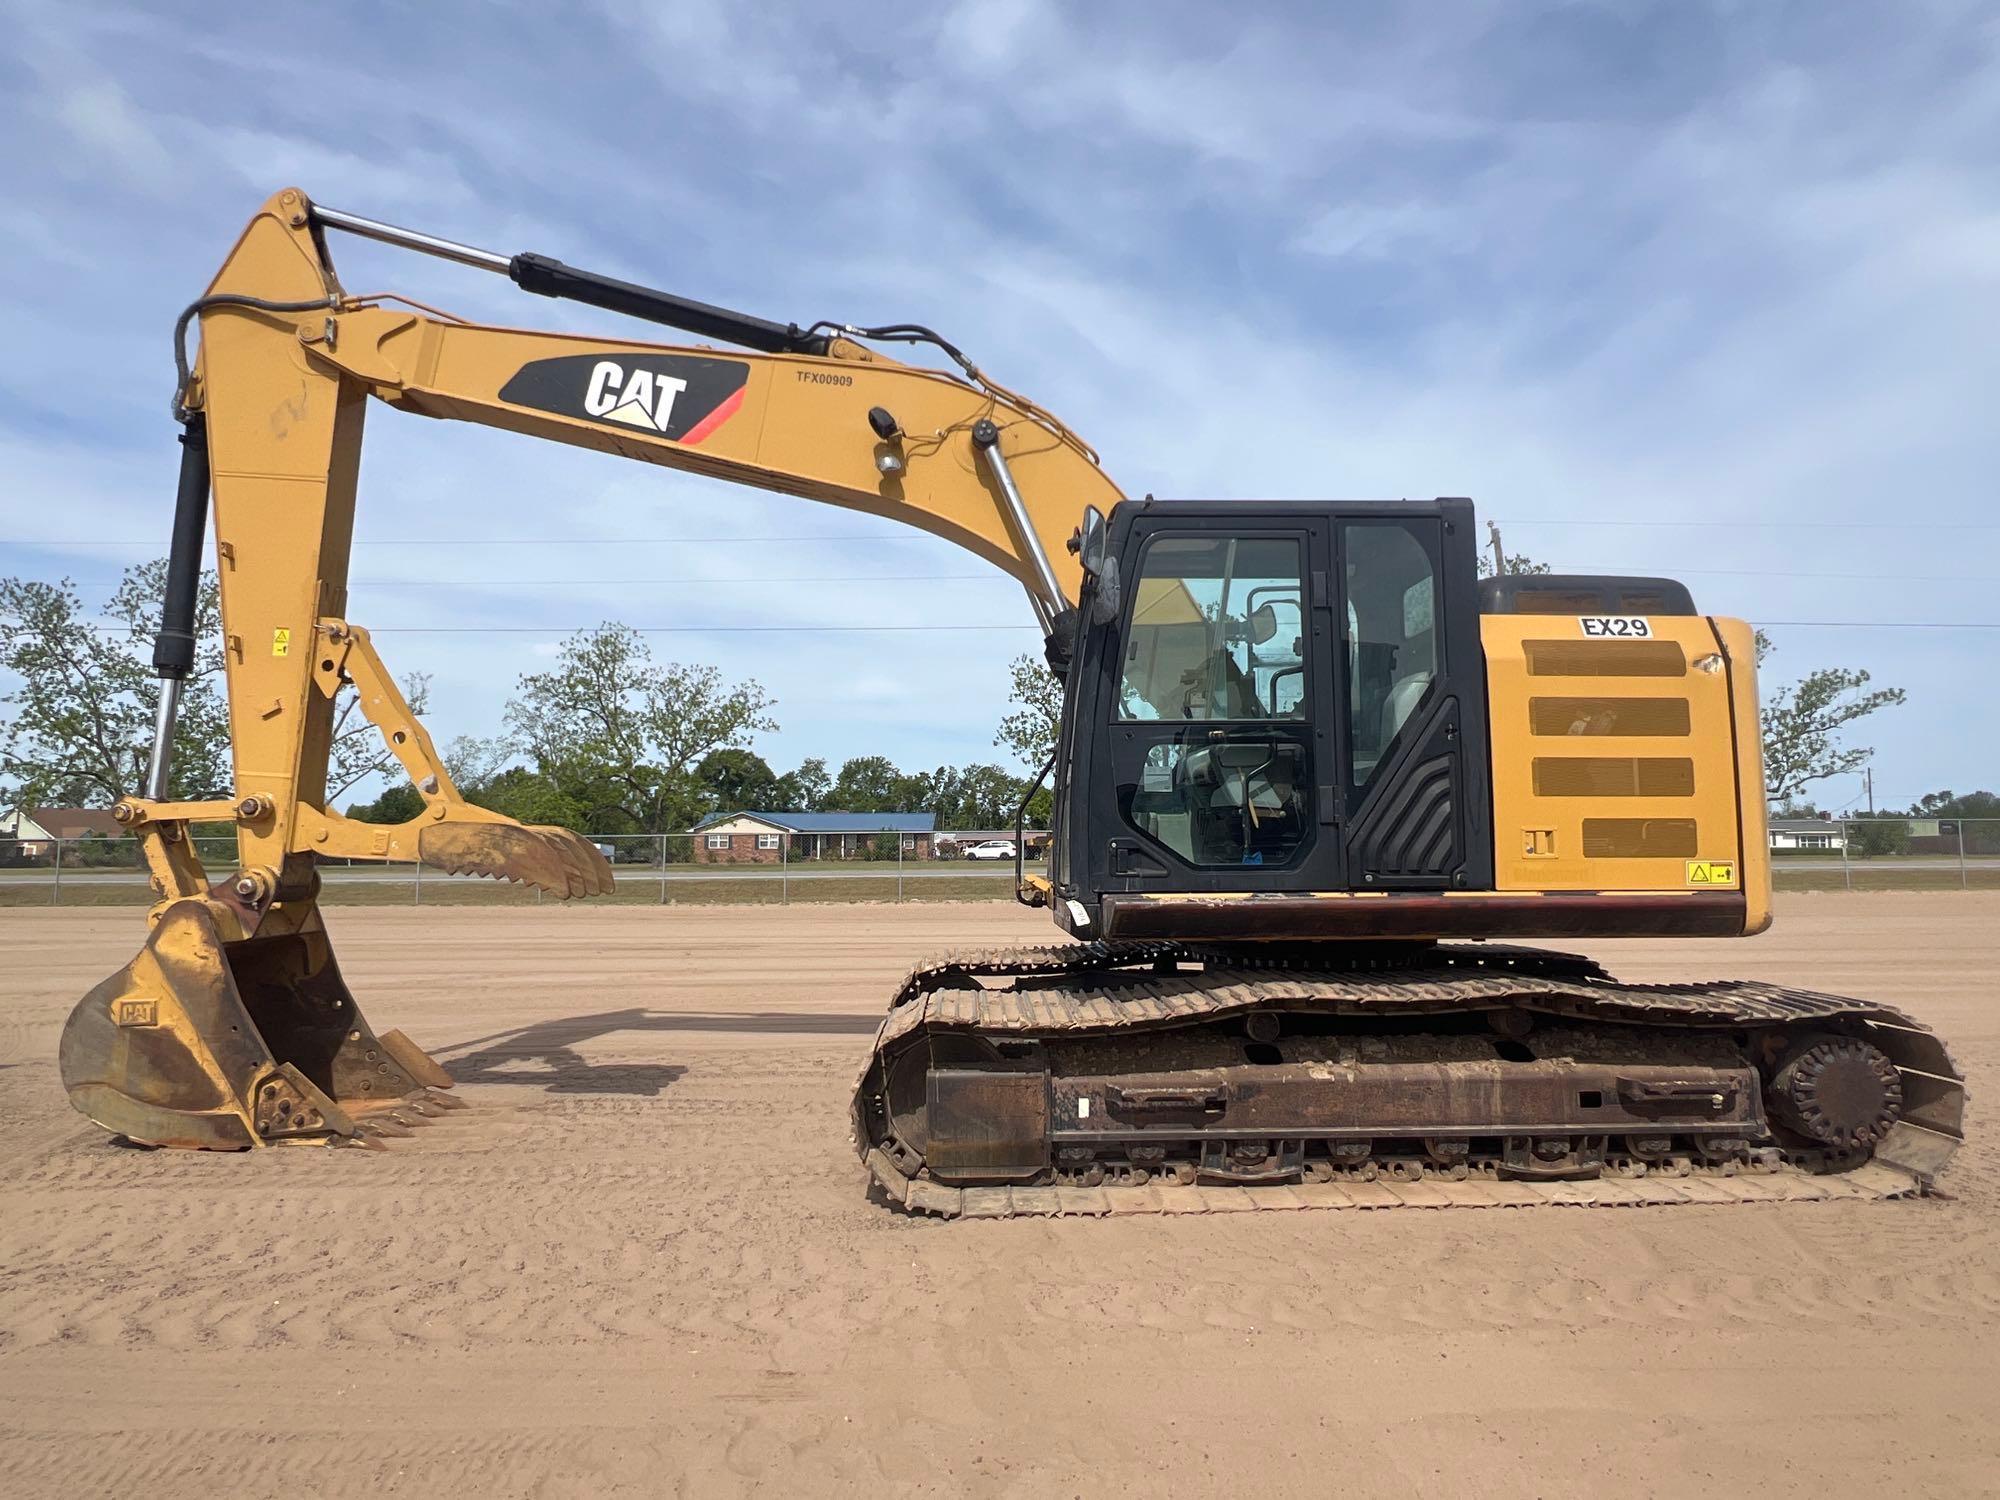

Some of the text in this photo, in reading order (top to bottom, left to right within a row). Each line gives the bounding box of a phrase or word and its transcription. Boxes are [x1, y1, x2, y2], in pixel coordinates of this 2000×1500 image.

[797, 371, 853, 387] TFX00909
[584, 361, 688, 432] CAT
[1581, 618, 1648, 636] EX29
[121, 1002, 153, 1024] CAT
